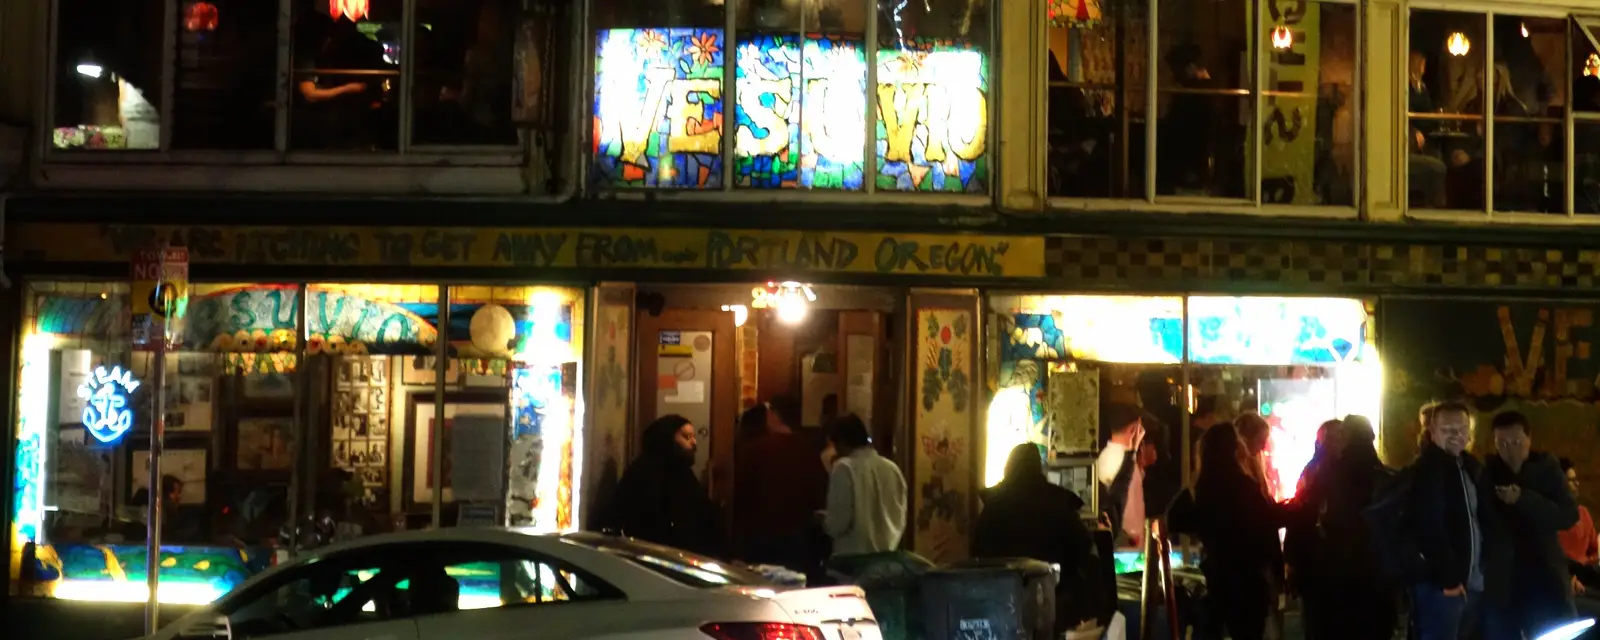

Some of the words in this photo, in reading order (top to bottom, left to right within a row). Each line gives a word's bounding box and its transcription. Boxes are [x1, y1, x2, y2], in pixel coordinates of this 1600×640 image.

[597, 66, 987, 164] VESUVIO
[420, 230, 477, 262] GET
[491, 232, 568, 264] AWAY
[575, 232, 657, 266] FROM
[706, 231, 859, 268] PORTLAND
[76, 365, 140, 401] STEAM
